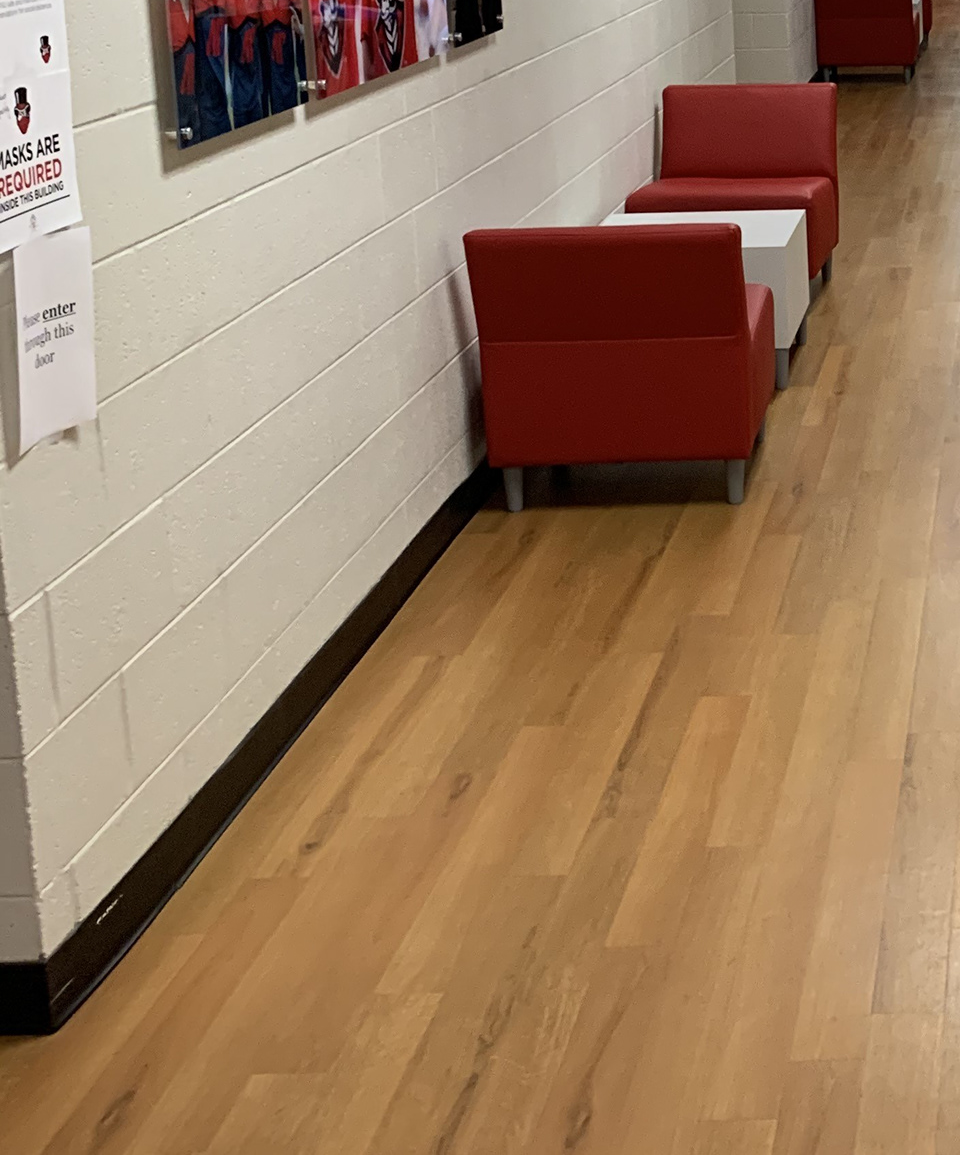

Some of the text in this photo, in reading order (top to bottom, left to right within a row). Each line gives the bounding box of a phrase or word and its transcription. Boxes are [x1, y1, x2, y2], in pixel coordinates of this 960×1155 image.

[36, 133, 60, 158] ARE
[0, 158, 62, 199] REQUIRED
[20, 191, 33, 204] THIS
[34, 180, 64, 200] BUILDING
[42, 302, 76, 321] enter
[54, 321, 74, 339] this
[35, 351, 55, 369] door
